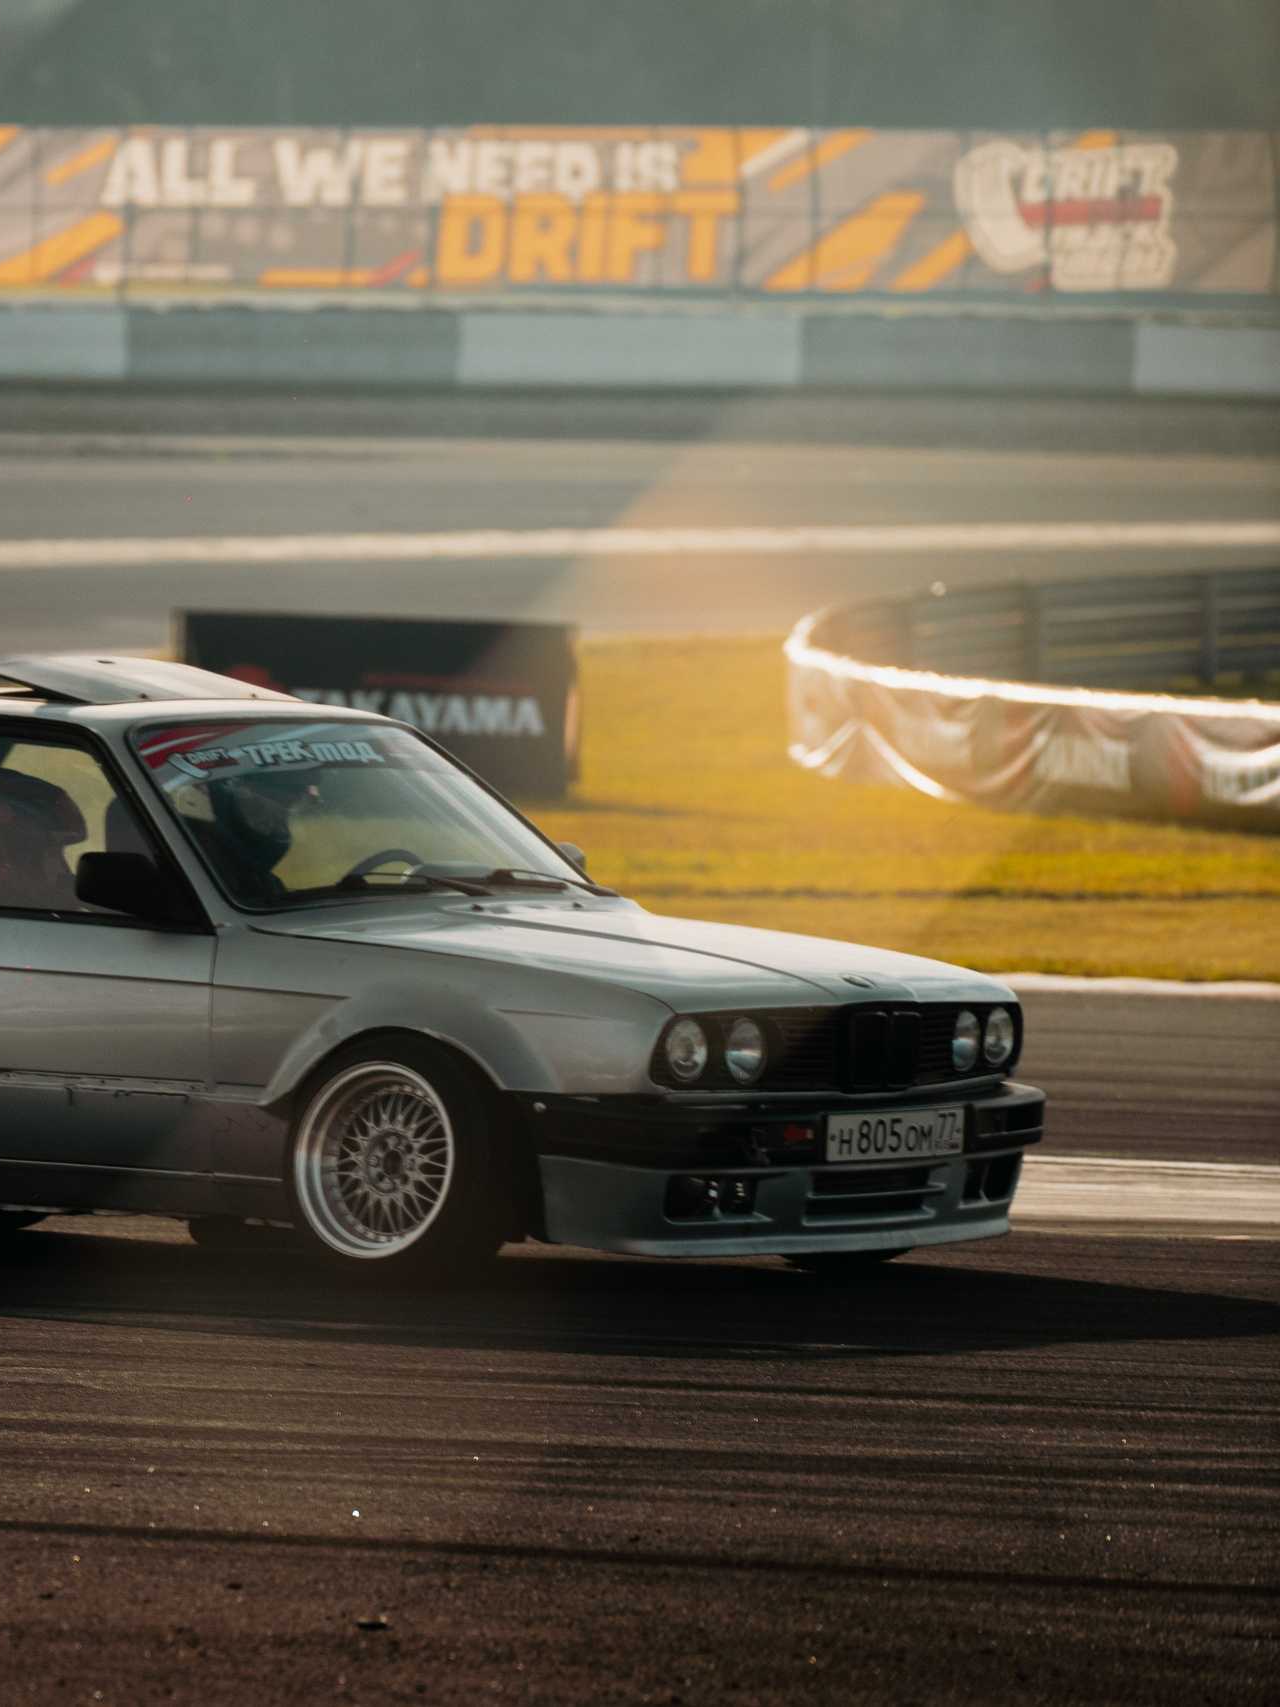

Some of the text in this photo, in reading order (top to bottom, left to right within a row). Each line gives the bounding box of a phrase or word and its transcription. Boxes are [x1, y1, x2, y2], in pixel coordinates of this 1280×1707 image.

[101, 136, 680, 208] ALL WE NEED IS
[435, 190, 740, 286] DRIFT
[186, 748, 231, 766] DRIFT
